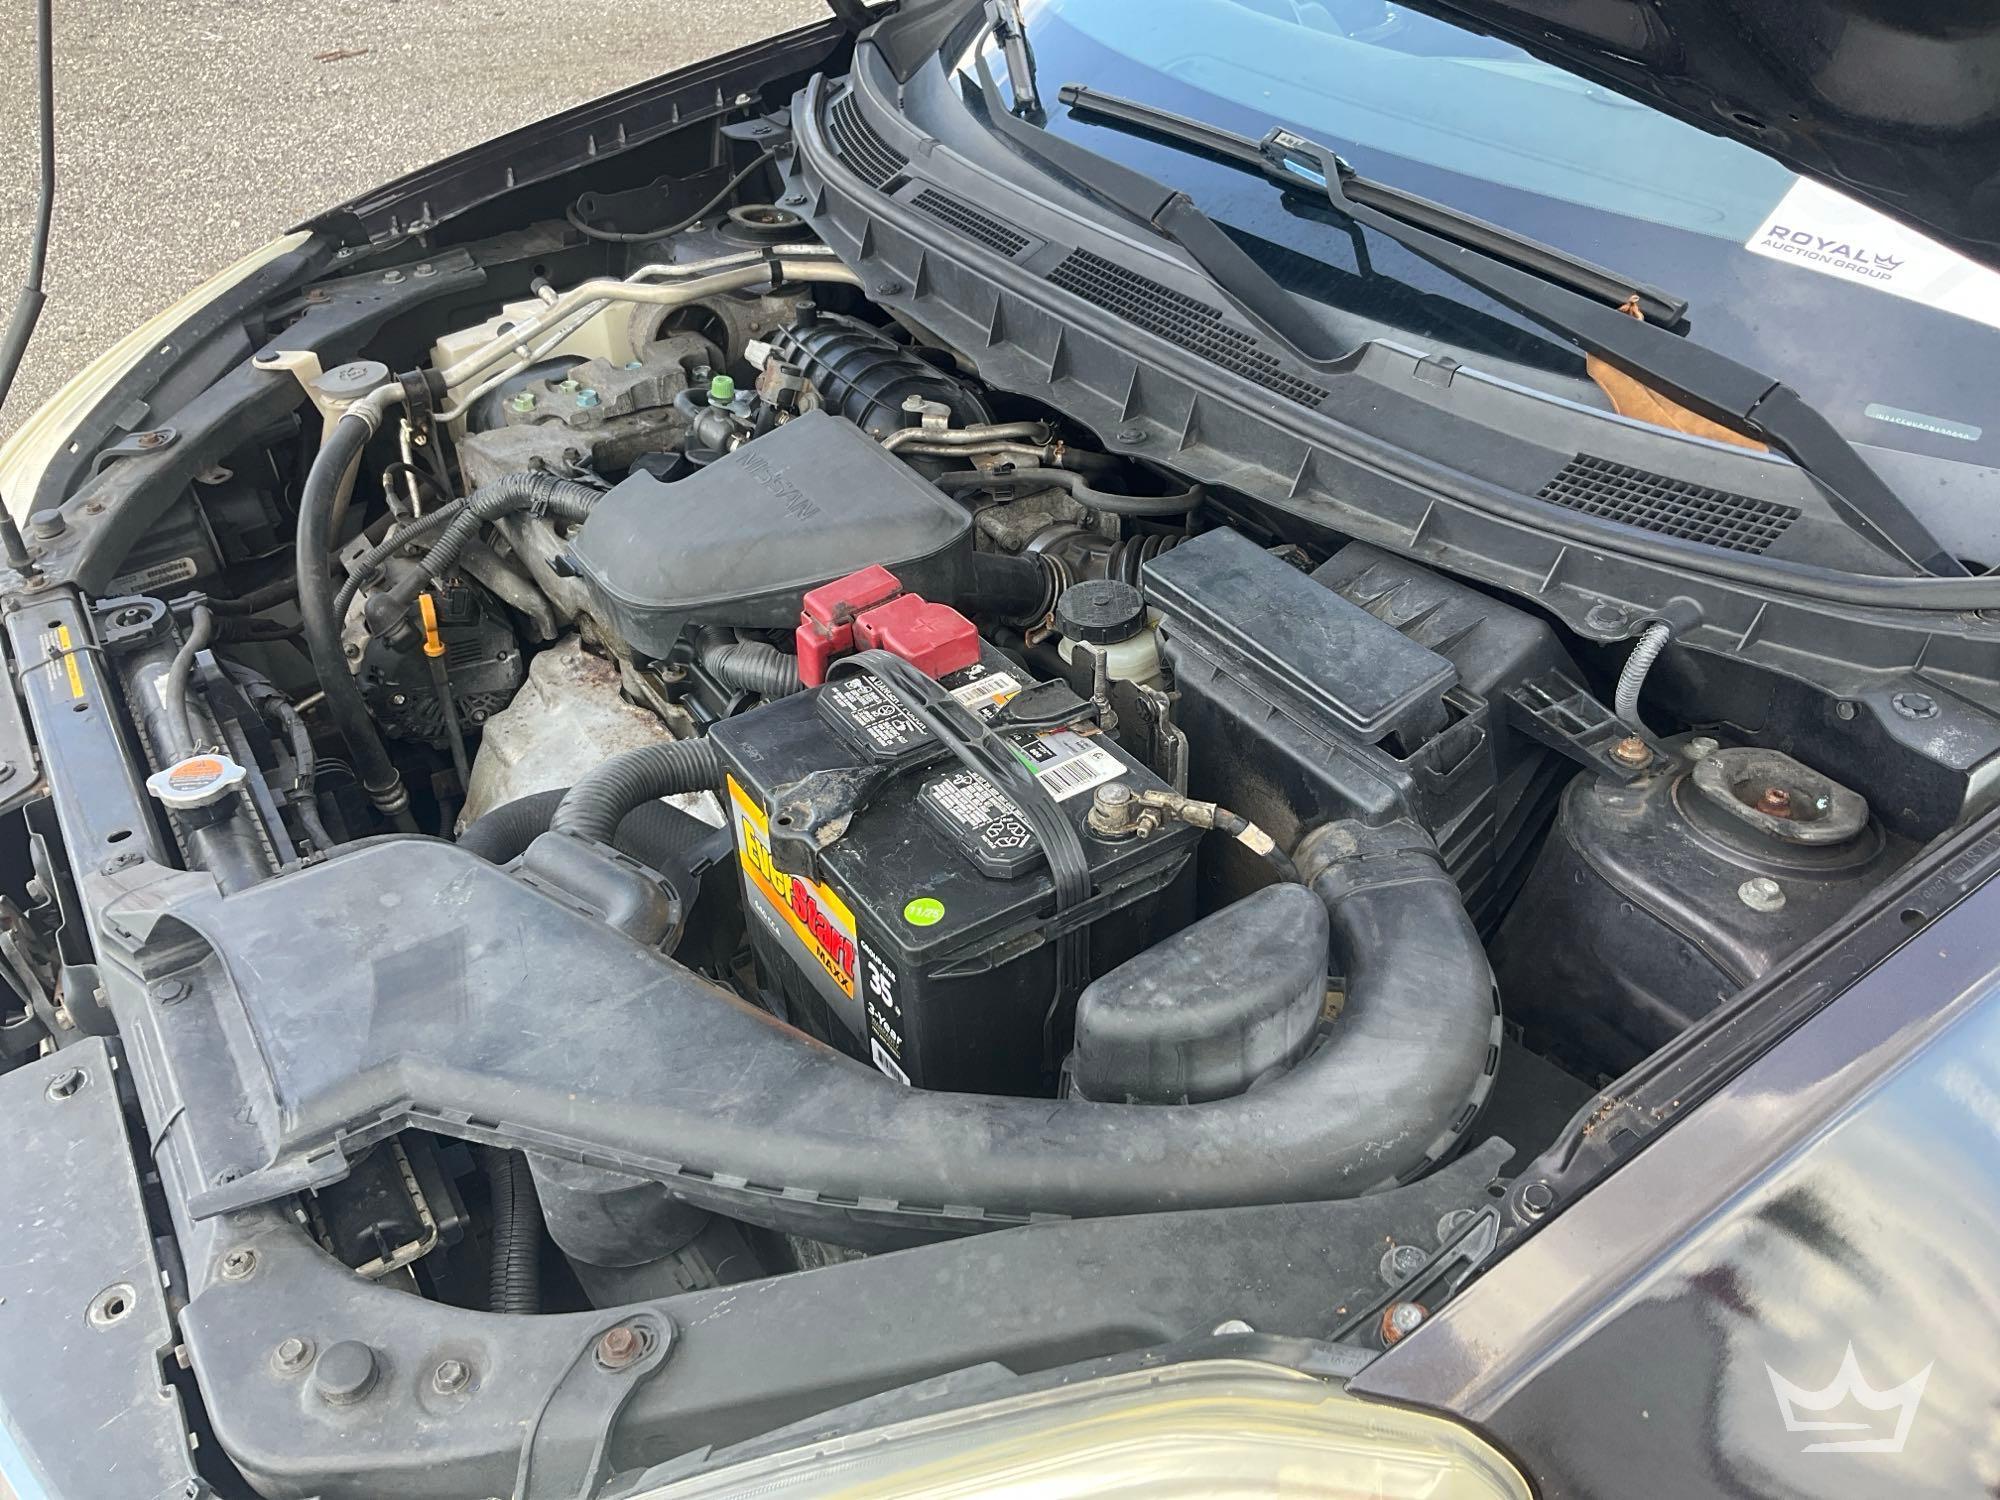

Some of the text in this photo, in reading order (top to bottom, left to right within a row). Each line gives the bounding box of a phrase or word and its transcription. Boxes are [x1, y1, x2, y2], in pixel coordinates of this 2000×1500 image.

[1760, 239, 1893, 281] AUCTION GROUP
[1767, 225, 1869, 264] ROYAL
[736, 449, 821, 521] NISSAN
[816, 945, 850, 992] MAXX
[868, 961, 893, 1008] 35
[868, 1001, 902, 1045] 3-Year
